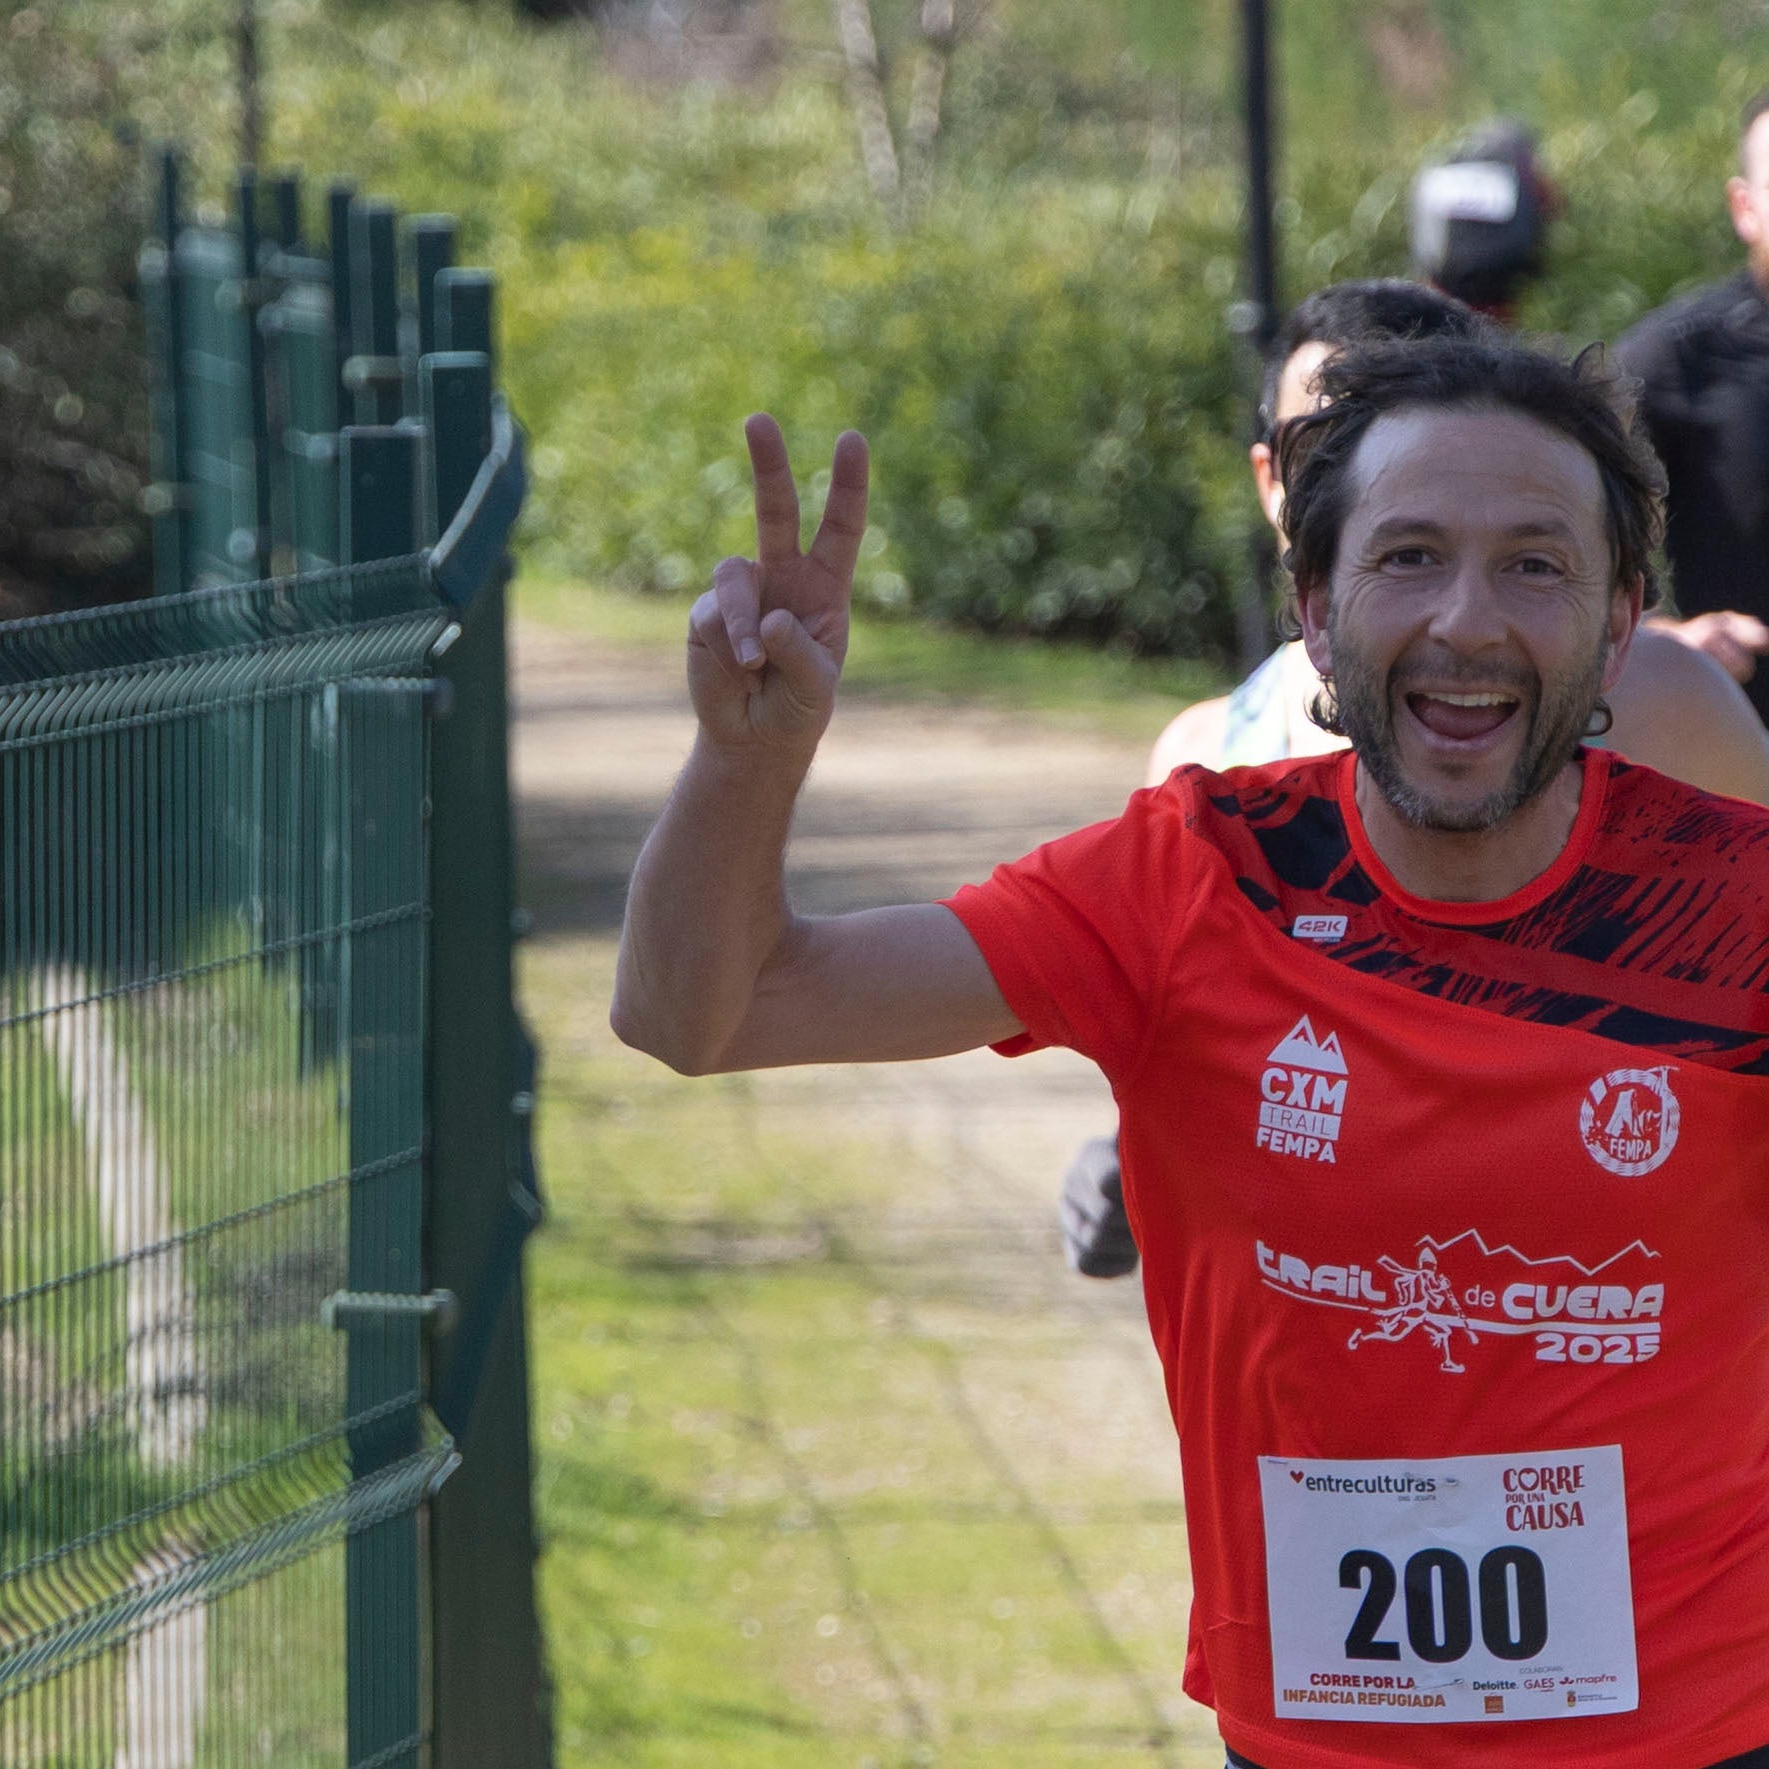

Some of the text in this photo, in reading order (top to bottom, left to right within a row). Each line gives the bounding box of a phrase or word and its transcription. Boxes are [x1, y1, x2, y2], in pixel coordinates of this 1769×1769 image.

[1298, 920, 1342, 932] 42K
[1261, 1067, 1348, 1114] CXM
[1268, 1106, 1332, 1136] TRAIL
[1256, 1126, 1336, 1163] FEMPA
[1610, 1138, 1652, 1160] FEMPA
[1464, 1284, 1495, 1307] de
[1501, 1283, 1664, 1319] CUERA
[1536, 1333, 1662, 1363] 2025
[1306, 1475, 1436, 1493] entreculturas
[1503, 1465, 1586, 1495] CORRE
[1506, 1493, 1546, 1504] POR UNA
[1506, 1501, 1585, 1531] CAUSA
[1339, 1545, 1548, 1663] 200
[1310, 1673, 1415, 1690] CORRE POR LA
[1523, 1678, 1555, 1689] GAES
[1576, 1674, 1617, 1684] mapfre
[1283, 1689, 1446, 1707] INFANCIA REFUGIADA
